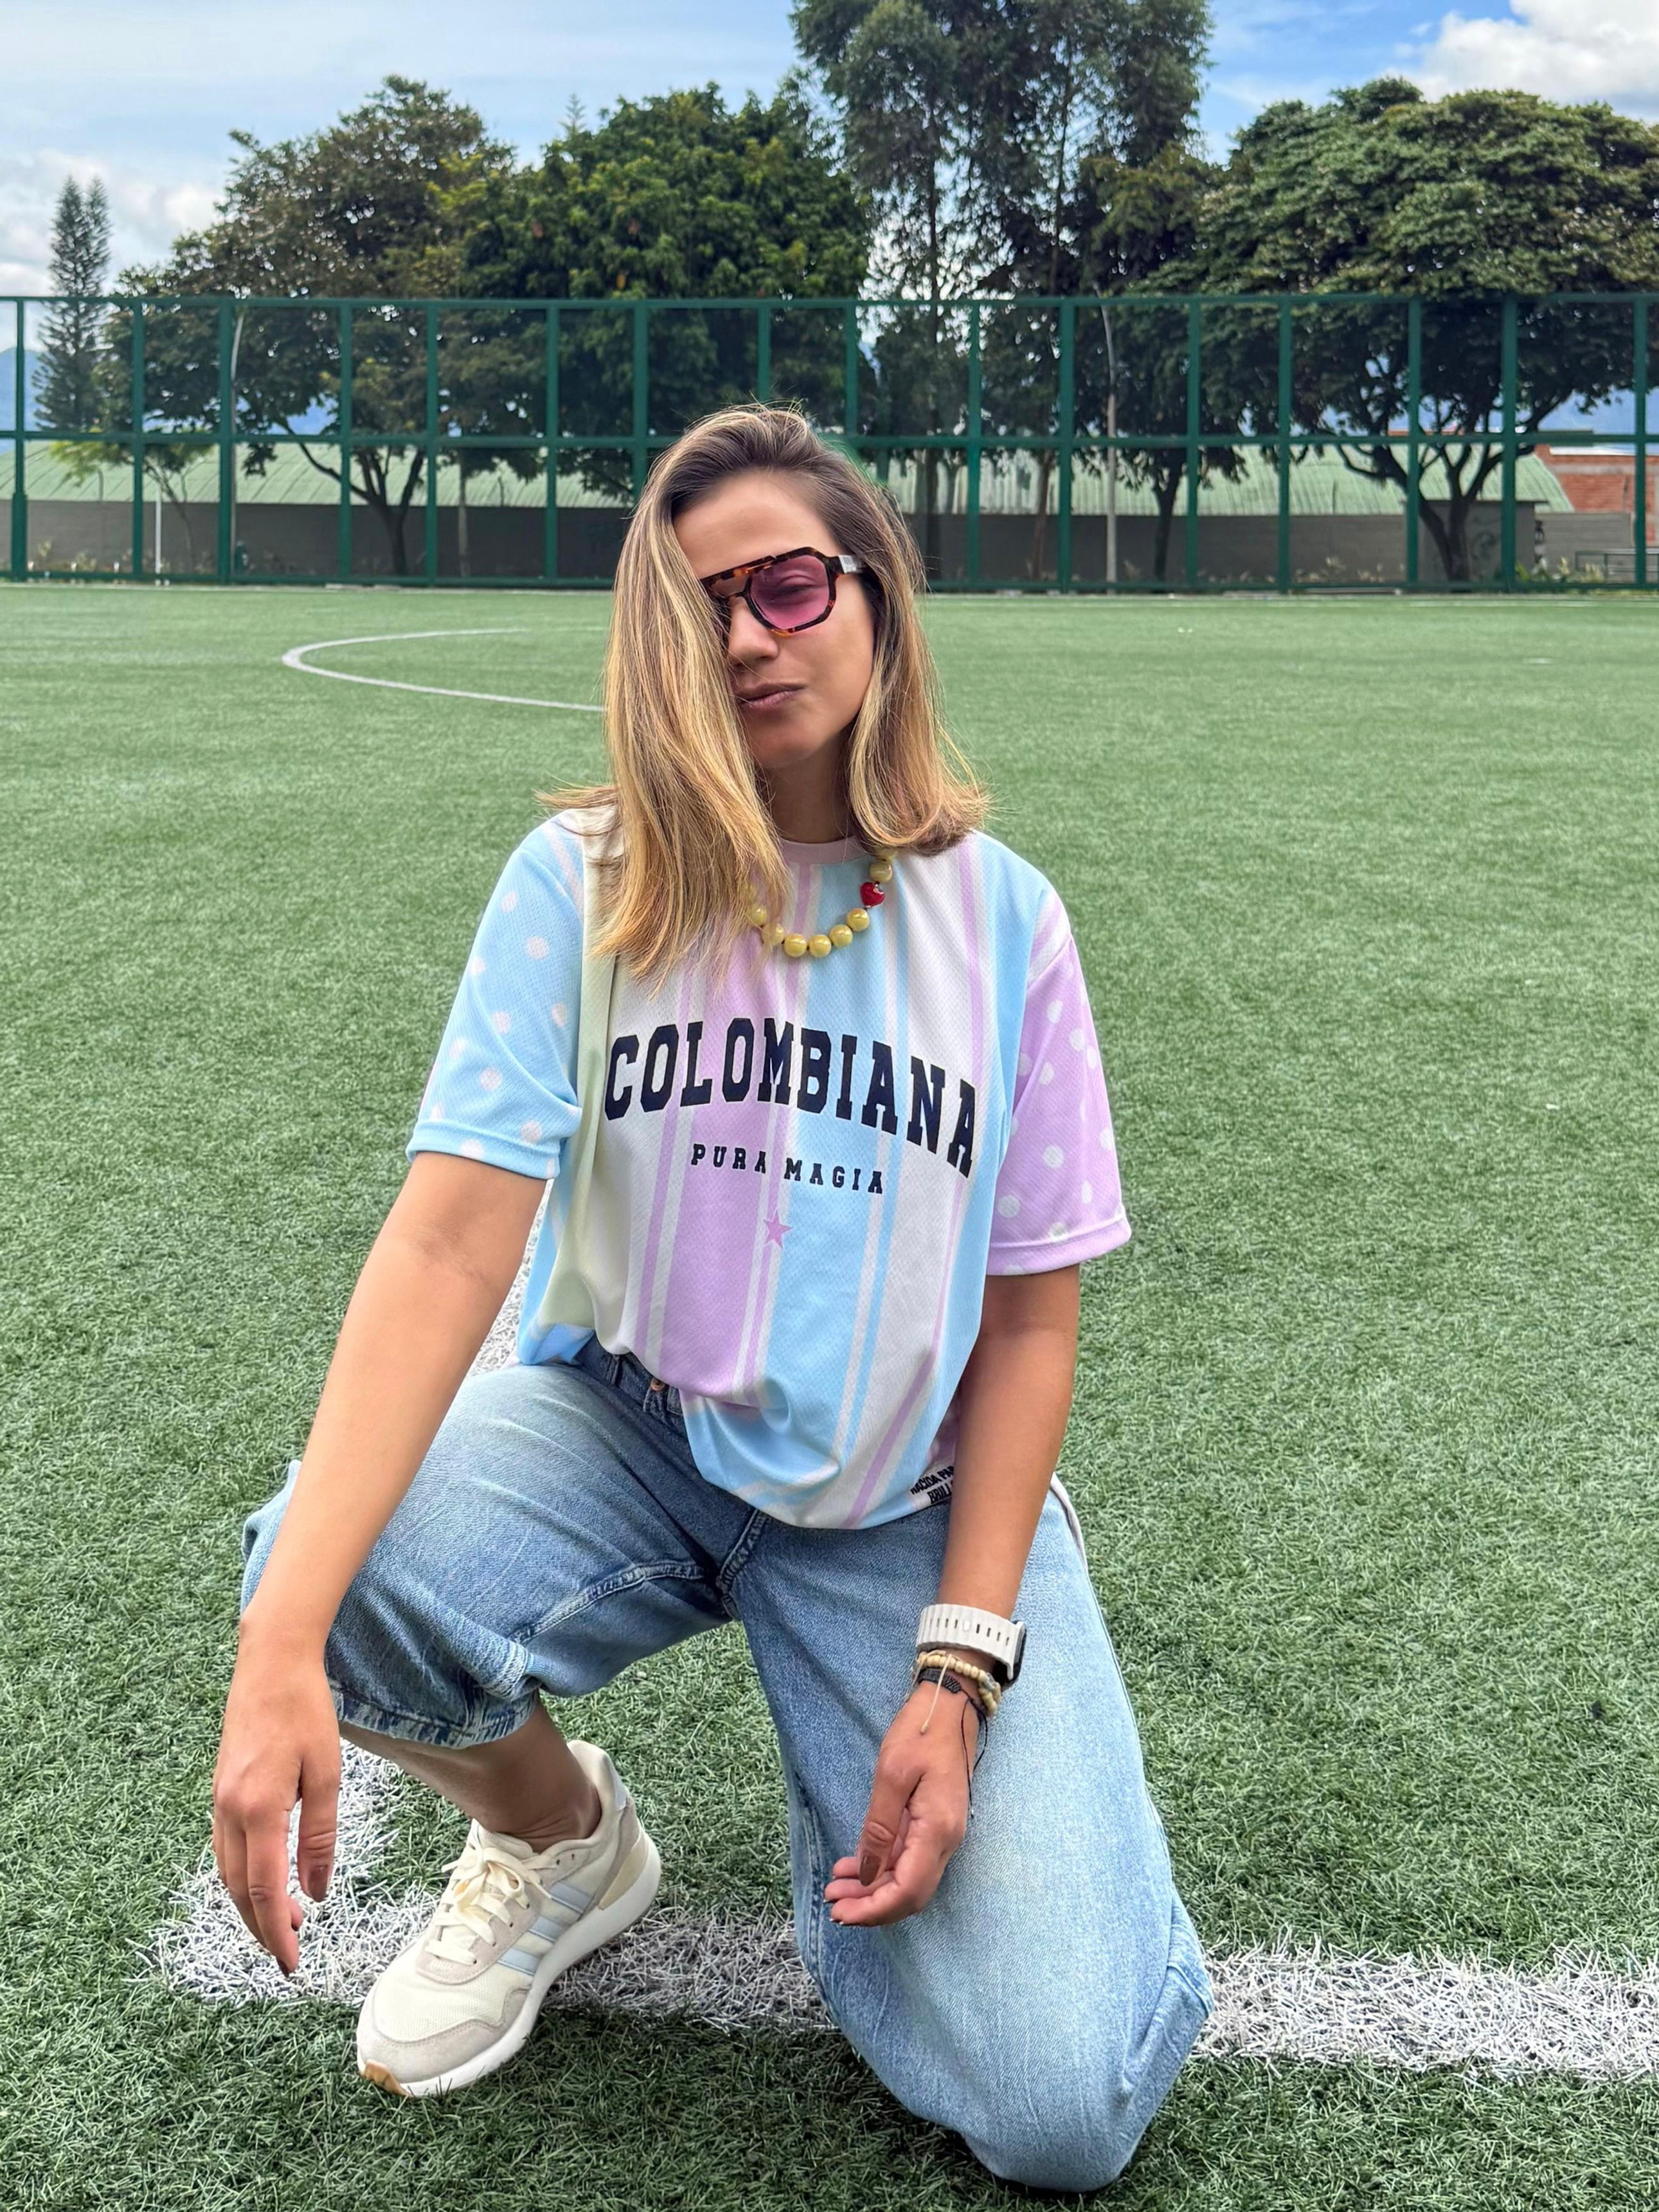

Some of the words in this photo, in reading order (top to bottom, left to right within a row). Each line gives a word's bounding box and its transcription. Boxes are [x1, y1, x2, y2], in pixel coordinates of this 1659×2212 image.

[604, 1017, 976, 1179] COLOMBIANA
[691, 1143, 767, 1175] PURA
[784, 1157, 883, 1195] MAGIA
